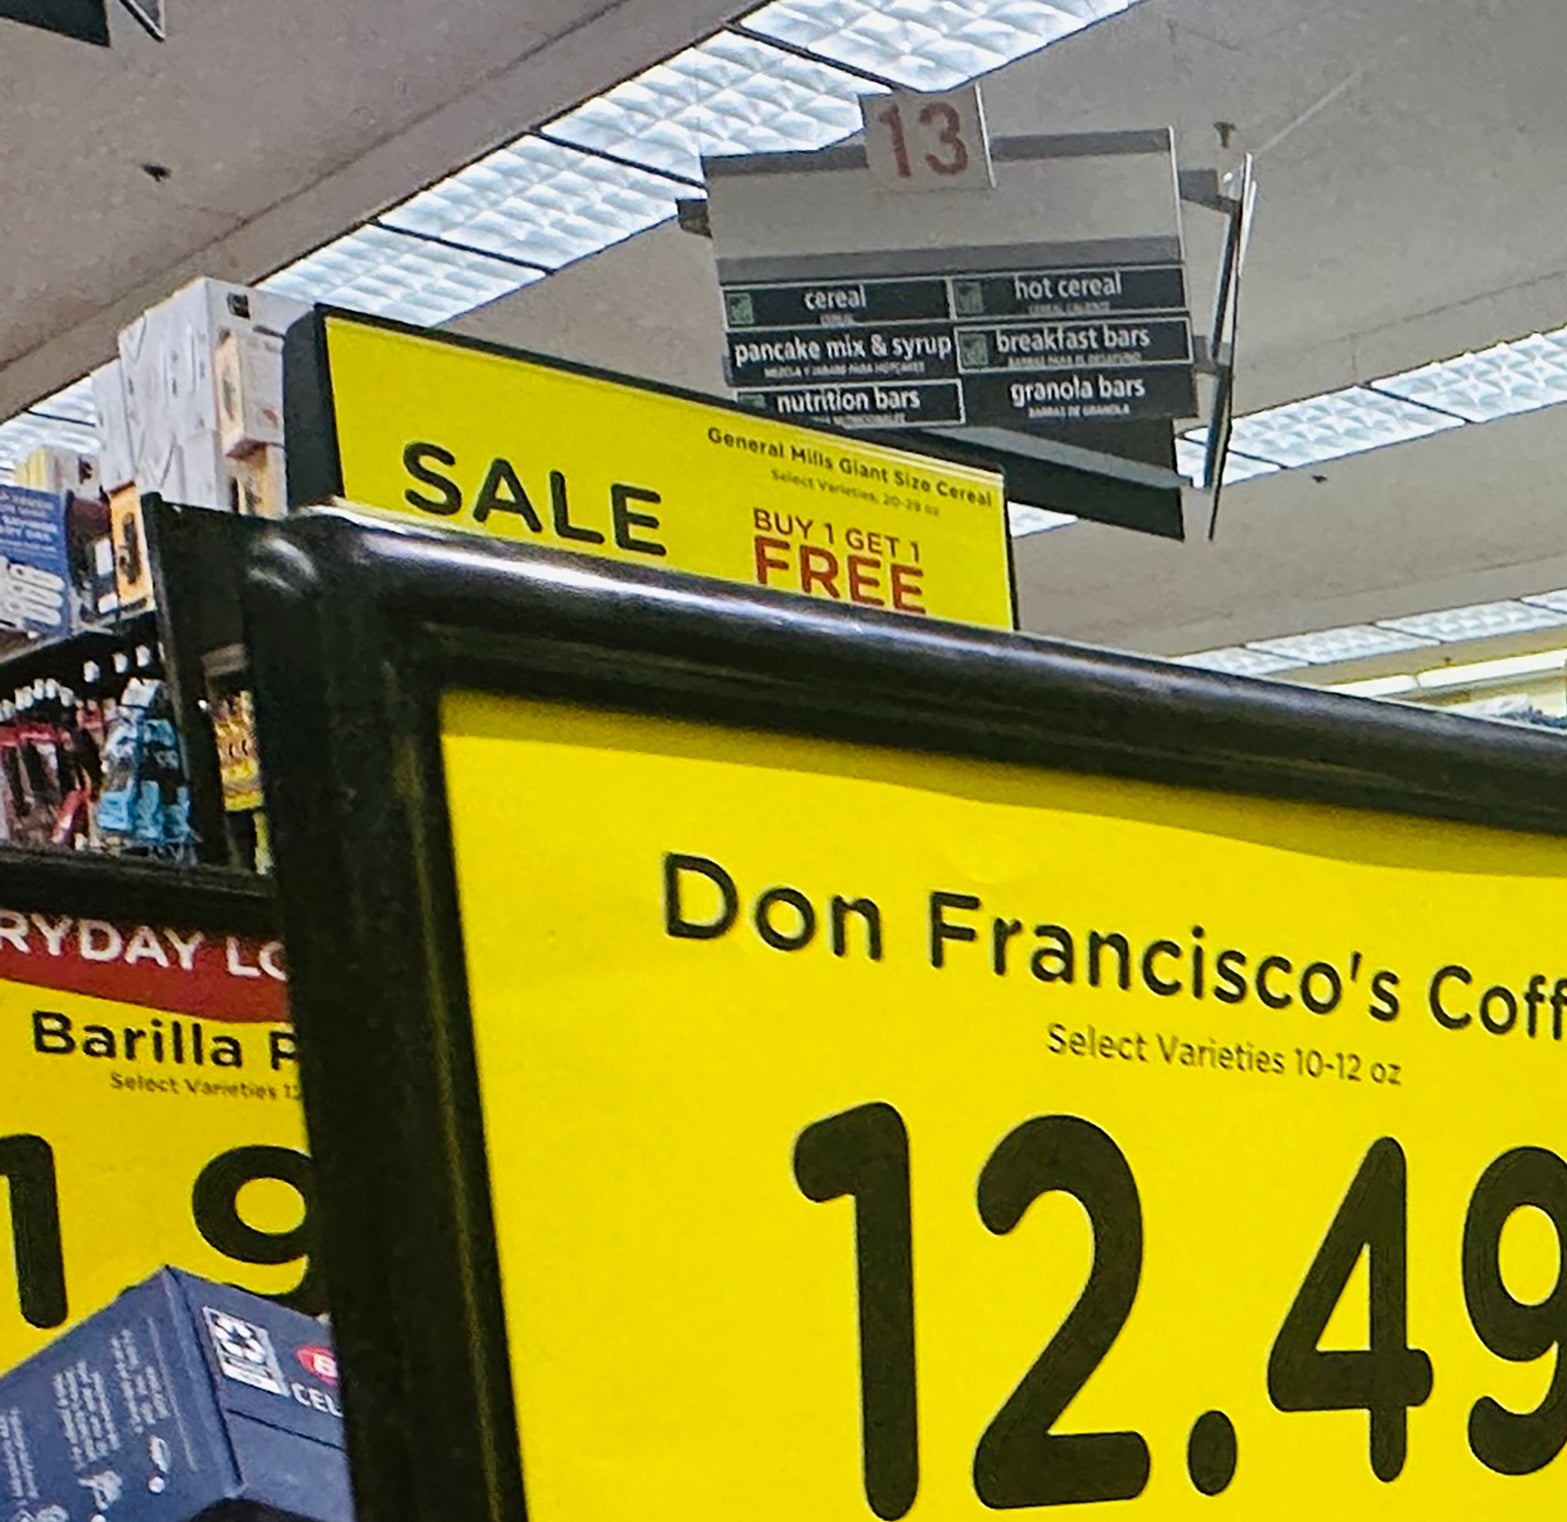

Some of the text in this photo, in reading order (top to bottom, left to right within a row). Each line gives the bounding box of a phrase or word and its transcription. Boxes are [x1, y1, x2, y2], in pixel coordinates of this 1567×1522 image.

[878, 102, 969, 178] 13
[804, 283, 868, 311] cereal
[1014, 269, 1123, 300] hot cereal
[734, 331, 953, 368] pancake mix & syrup
[996, 322, 1151, 354] breakfast bars
[776, 385, 921, 414] nutrition bars
[1010, 374, 1147, 408] granola bars
[707, 426, 992, 508] General Mills Giant Size Cereal
[402, 441, 668, 557] SALE
[754, 507, 921, 562] BUY 1 GET 1
[755, 536, 927, 616] FREE
[662, 850, 885, 963] Don
[927, 890, 1403, 1025] Francisco's
[32, 1009, 244, 1069] Barilla
[1046, 1021, 1405, 1087] Select Varieties 10-12 oz
[109, 1070, 277, 1101] Select Varieties
